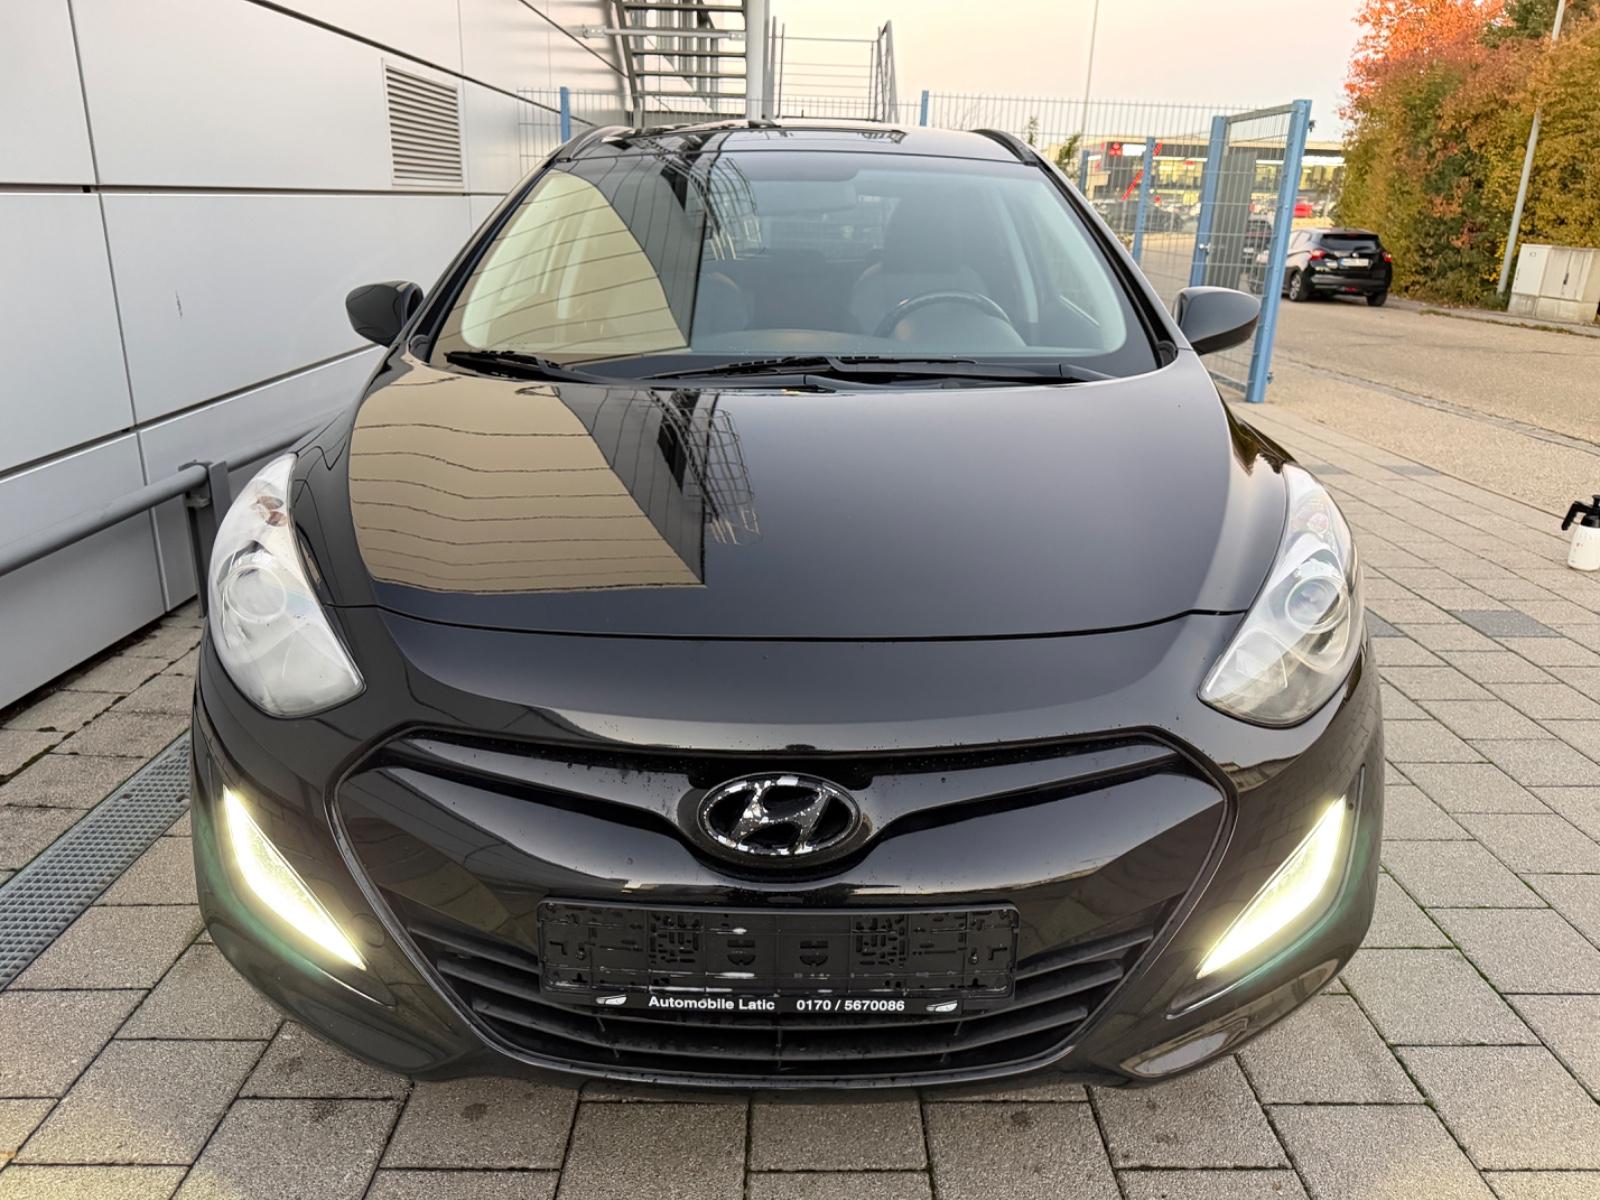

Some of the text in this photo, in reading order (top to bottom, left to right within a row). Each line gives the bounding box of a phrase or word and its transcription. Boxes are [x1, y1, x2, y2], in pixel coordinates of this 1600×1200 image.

[648, 996, 906, 1012] Automobile Latic 0170 / 5670086
